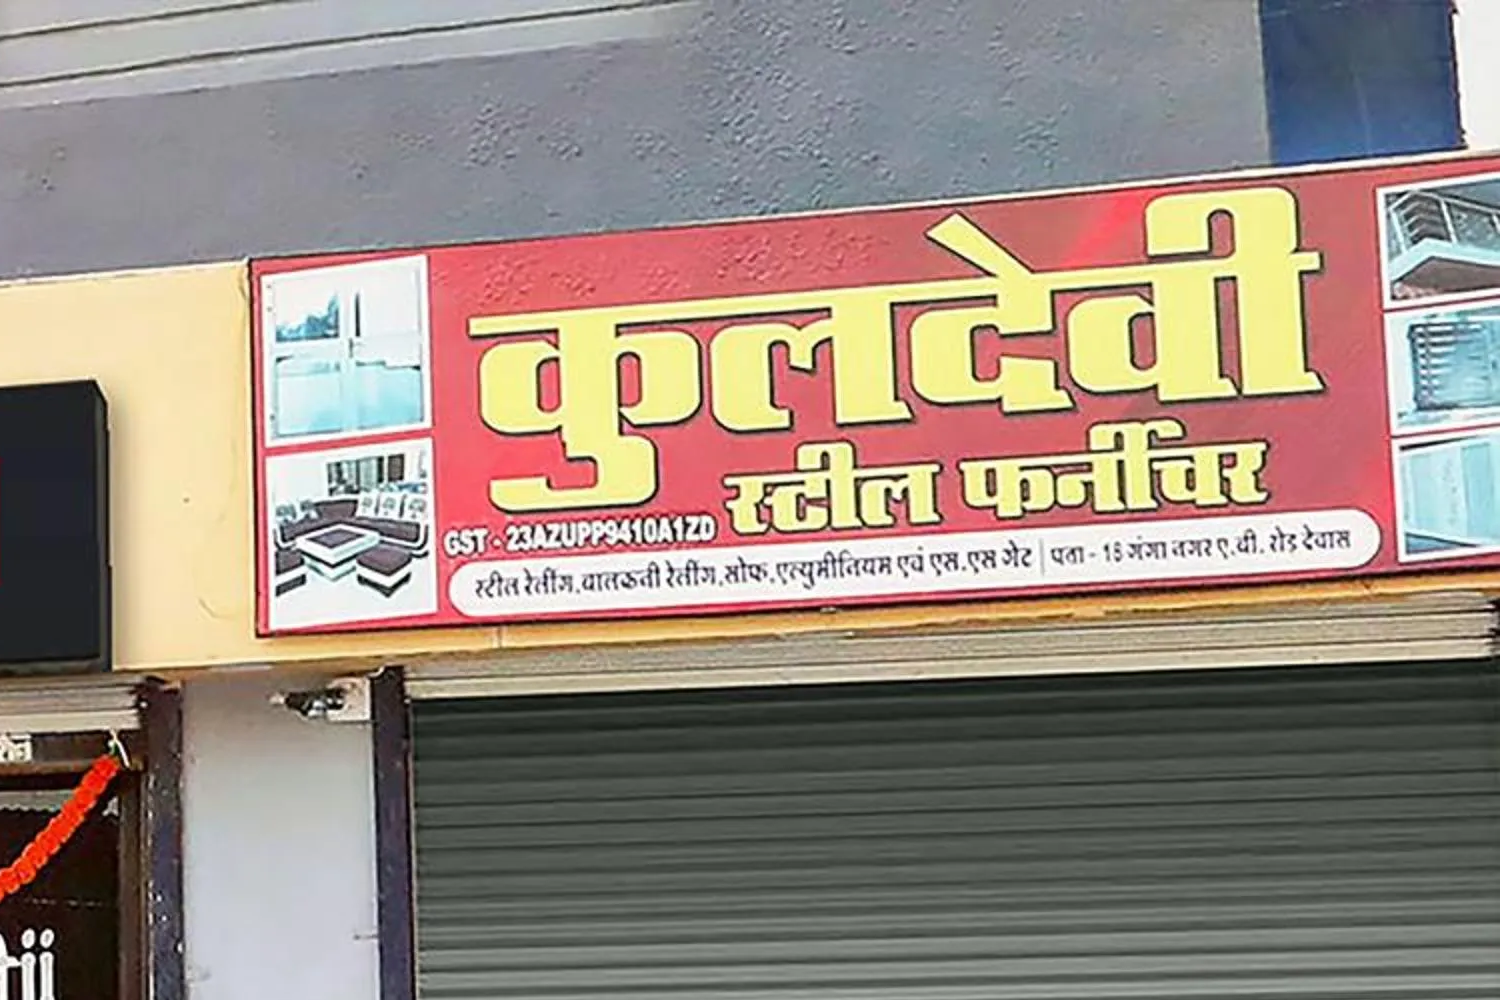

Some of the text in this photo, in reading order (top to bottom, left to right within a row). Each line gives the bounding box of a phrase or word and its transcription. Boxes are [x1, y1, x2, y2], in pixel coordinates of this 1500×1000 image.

[467, 186, 1327, 512] कुलदेवी
[723, 418, 1269, 536] स्टील फर्नीचर
[443, 527, 489, 556] GST
[475, 570, 520, 599] स्टील
[1269, 525, 1298, 553] रोड
